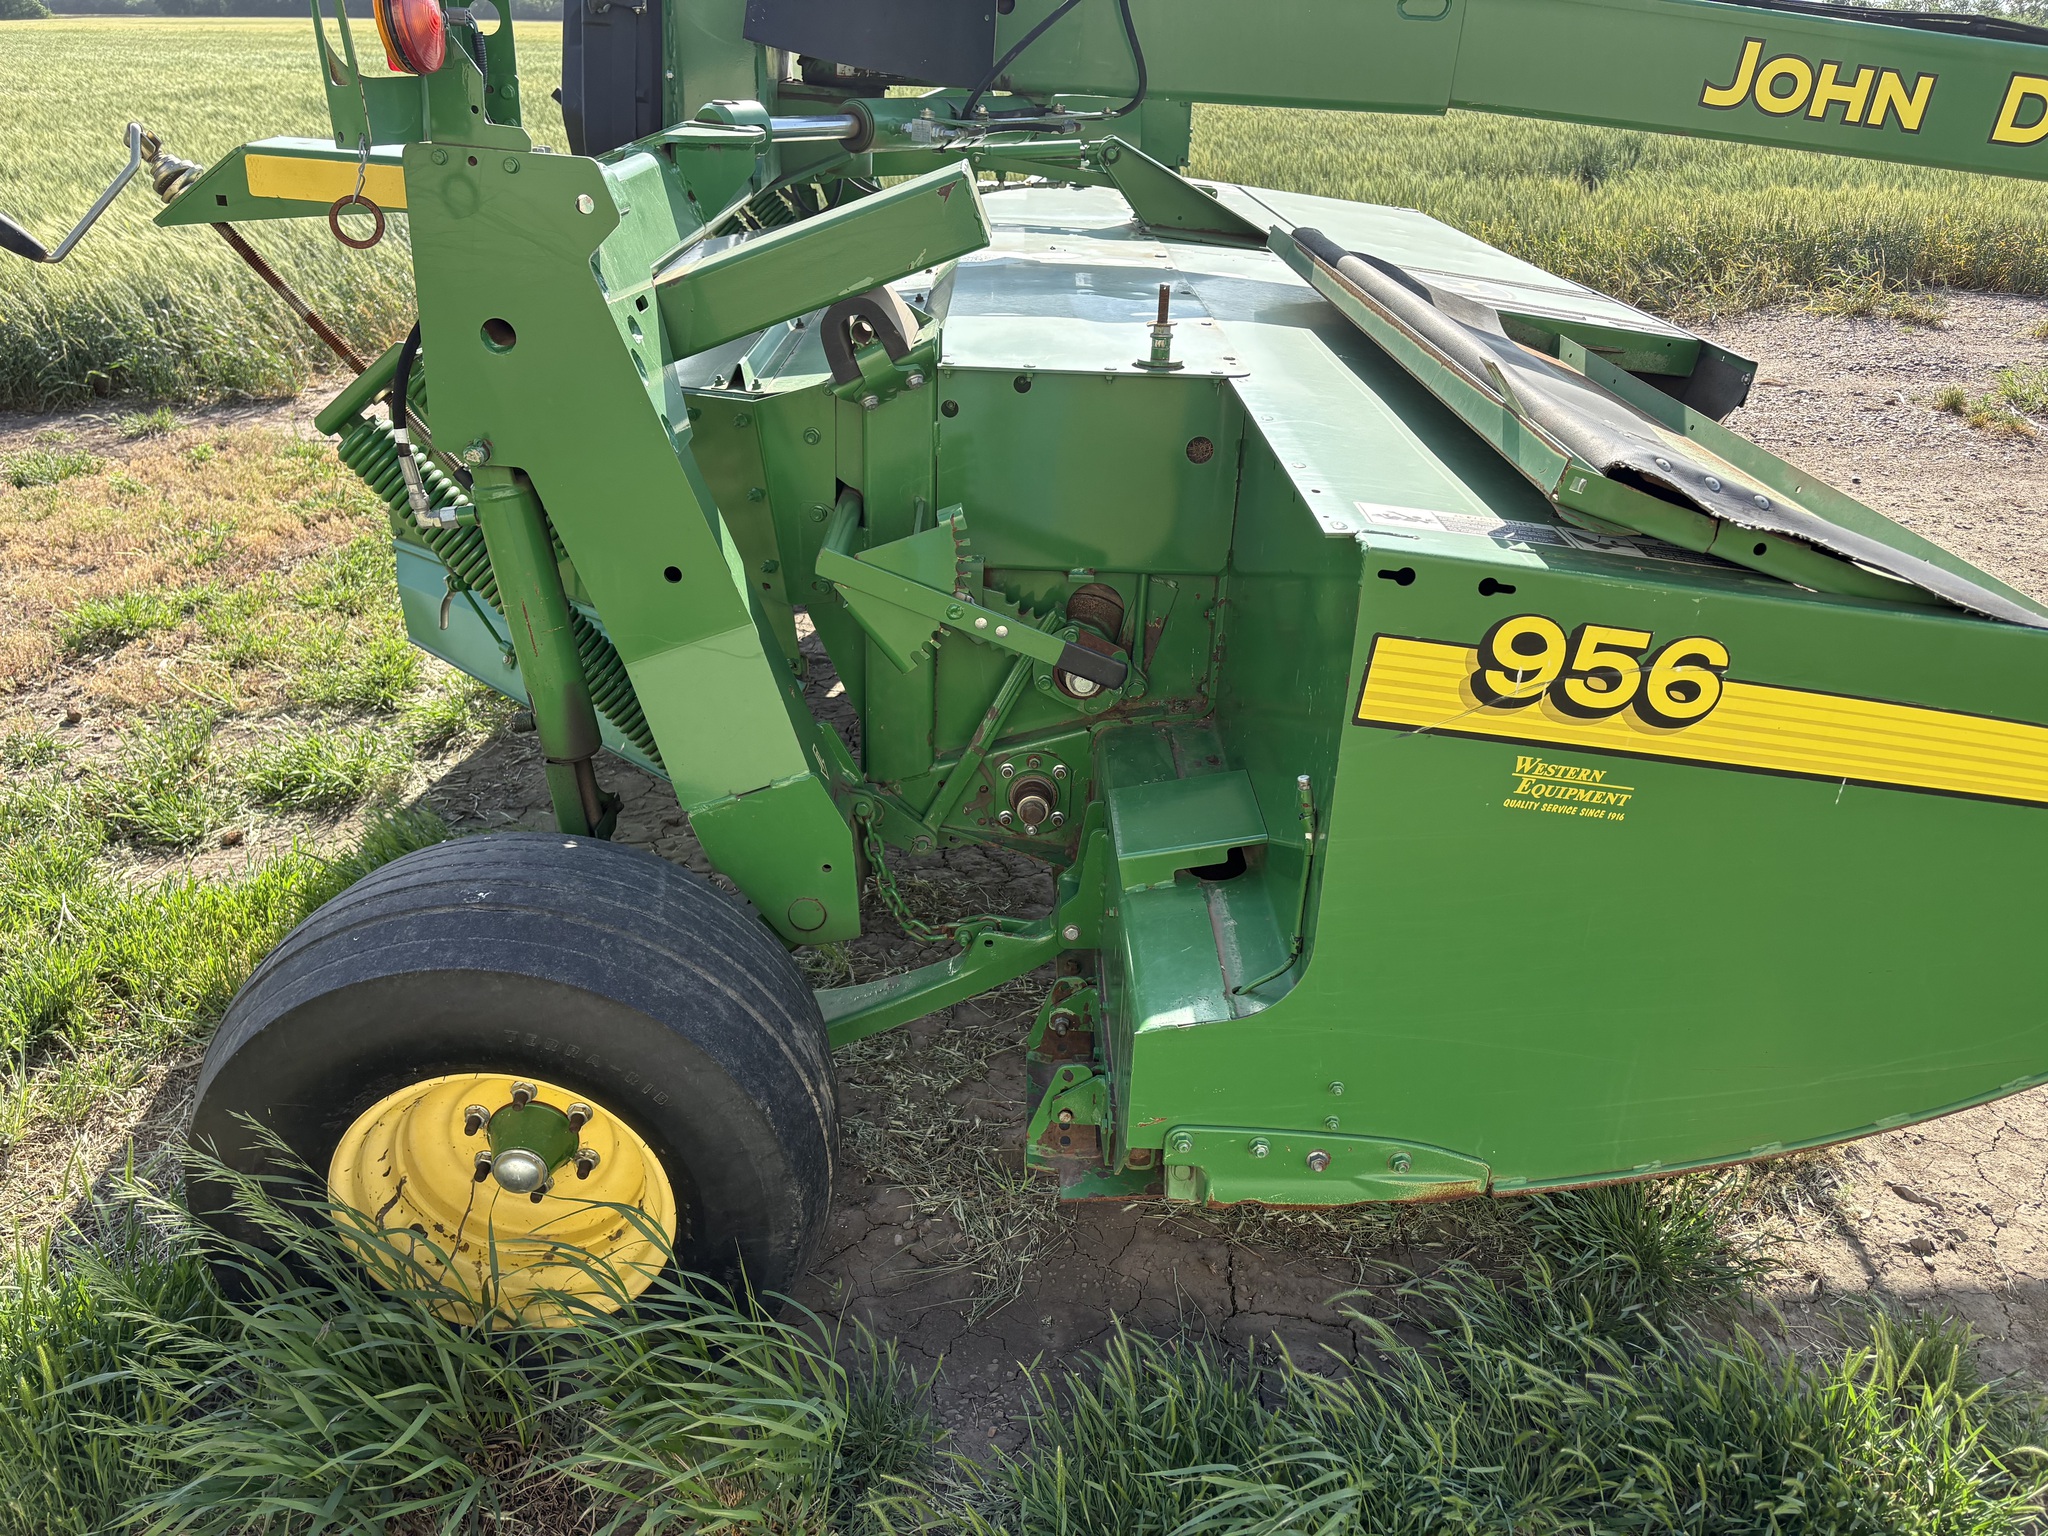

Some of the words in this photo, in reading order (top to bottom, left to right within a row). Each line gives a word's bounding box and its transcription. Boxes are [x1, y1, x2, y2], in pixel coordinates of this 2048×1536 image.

[1699, 37, 1938, 134] JOHN
[1476, 613, 1730, 729] 956
[1514, 755, 1607, 783] WESTERN
[1512, 777, 1632, 807] EQUIPMENT
[1503, 798, 1541, 811] QUALITY
[1540, 803, 1578, 816] SERVICE
[1579, 807, 1606, 819] SINCE
[1607, 811, 1625, 821] 1916
